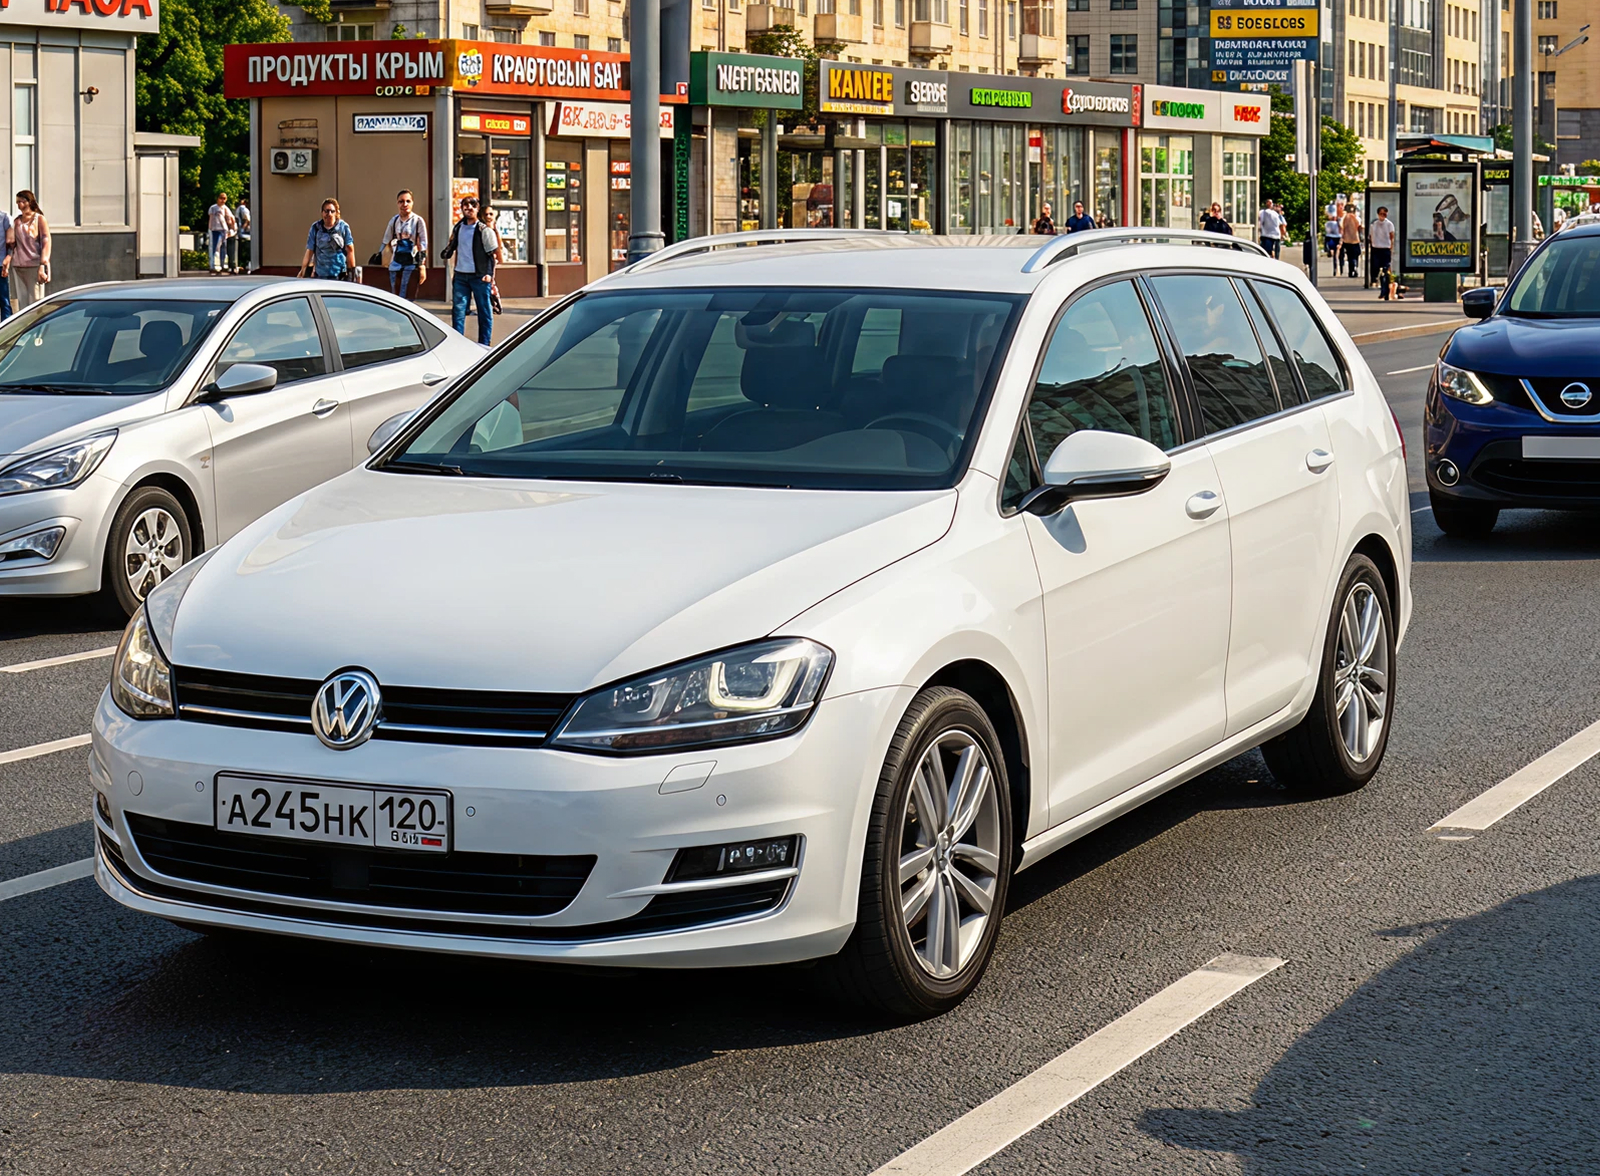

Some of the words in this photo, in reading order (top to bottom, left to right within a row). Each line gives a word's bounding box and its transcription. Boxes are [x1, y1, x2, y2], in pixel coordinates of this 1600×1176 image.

[248, 53, 368, 87] ПРОДУКТЫ
[375, 51, 444, 80] КРЫМ
[227, 788, 369, 838] А245НК
